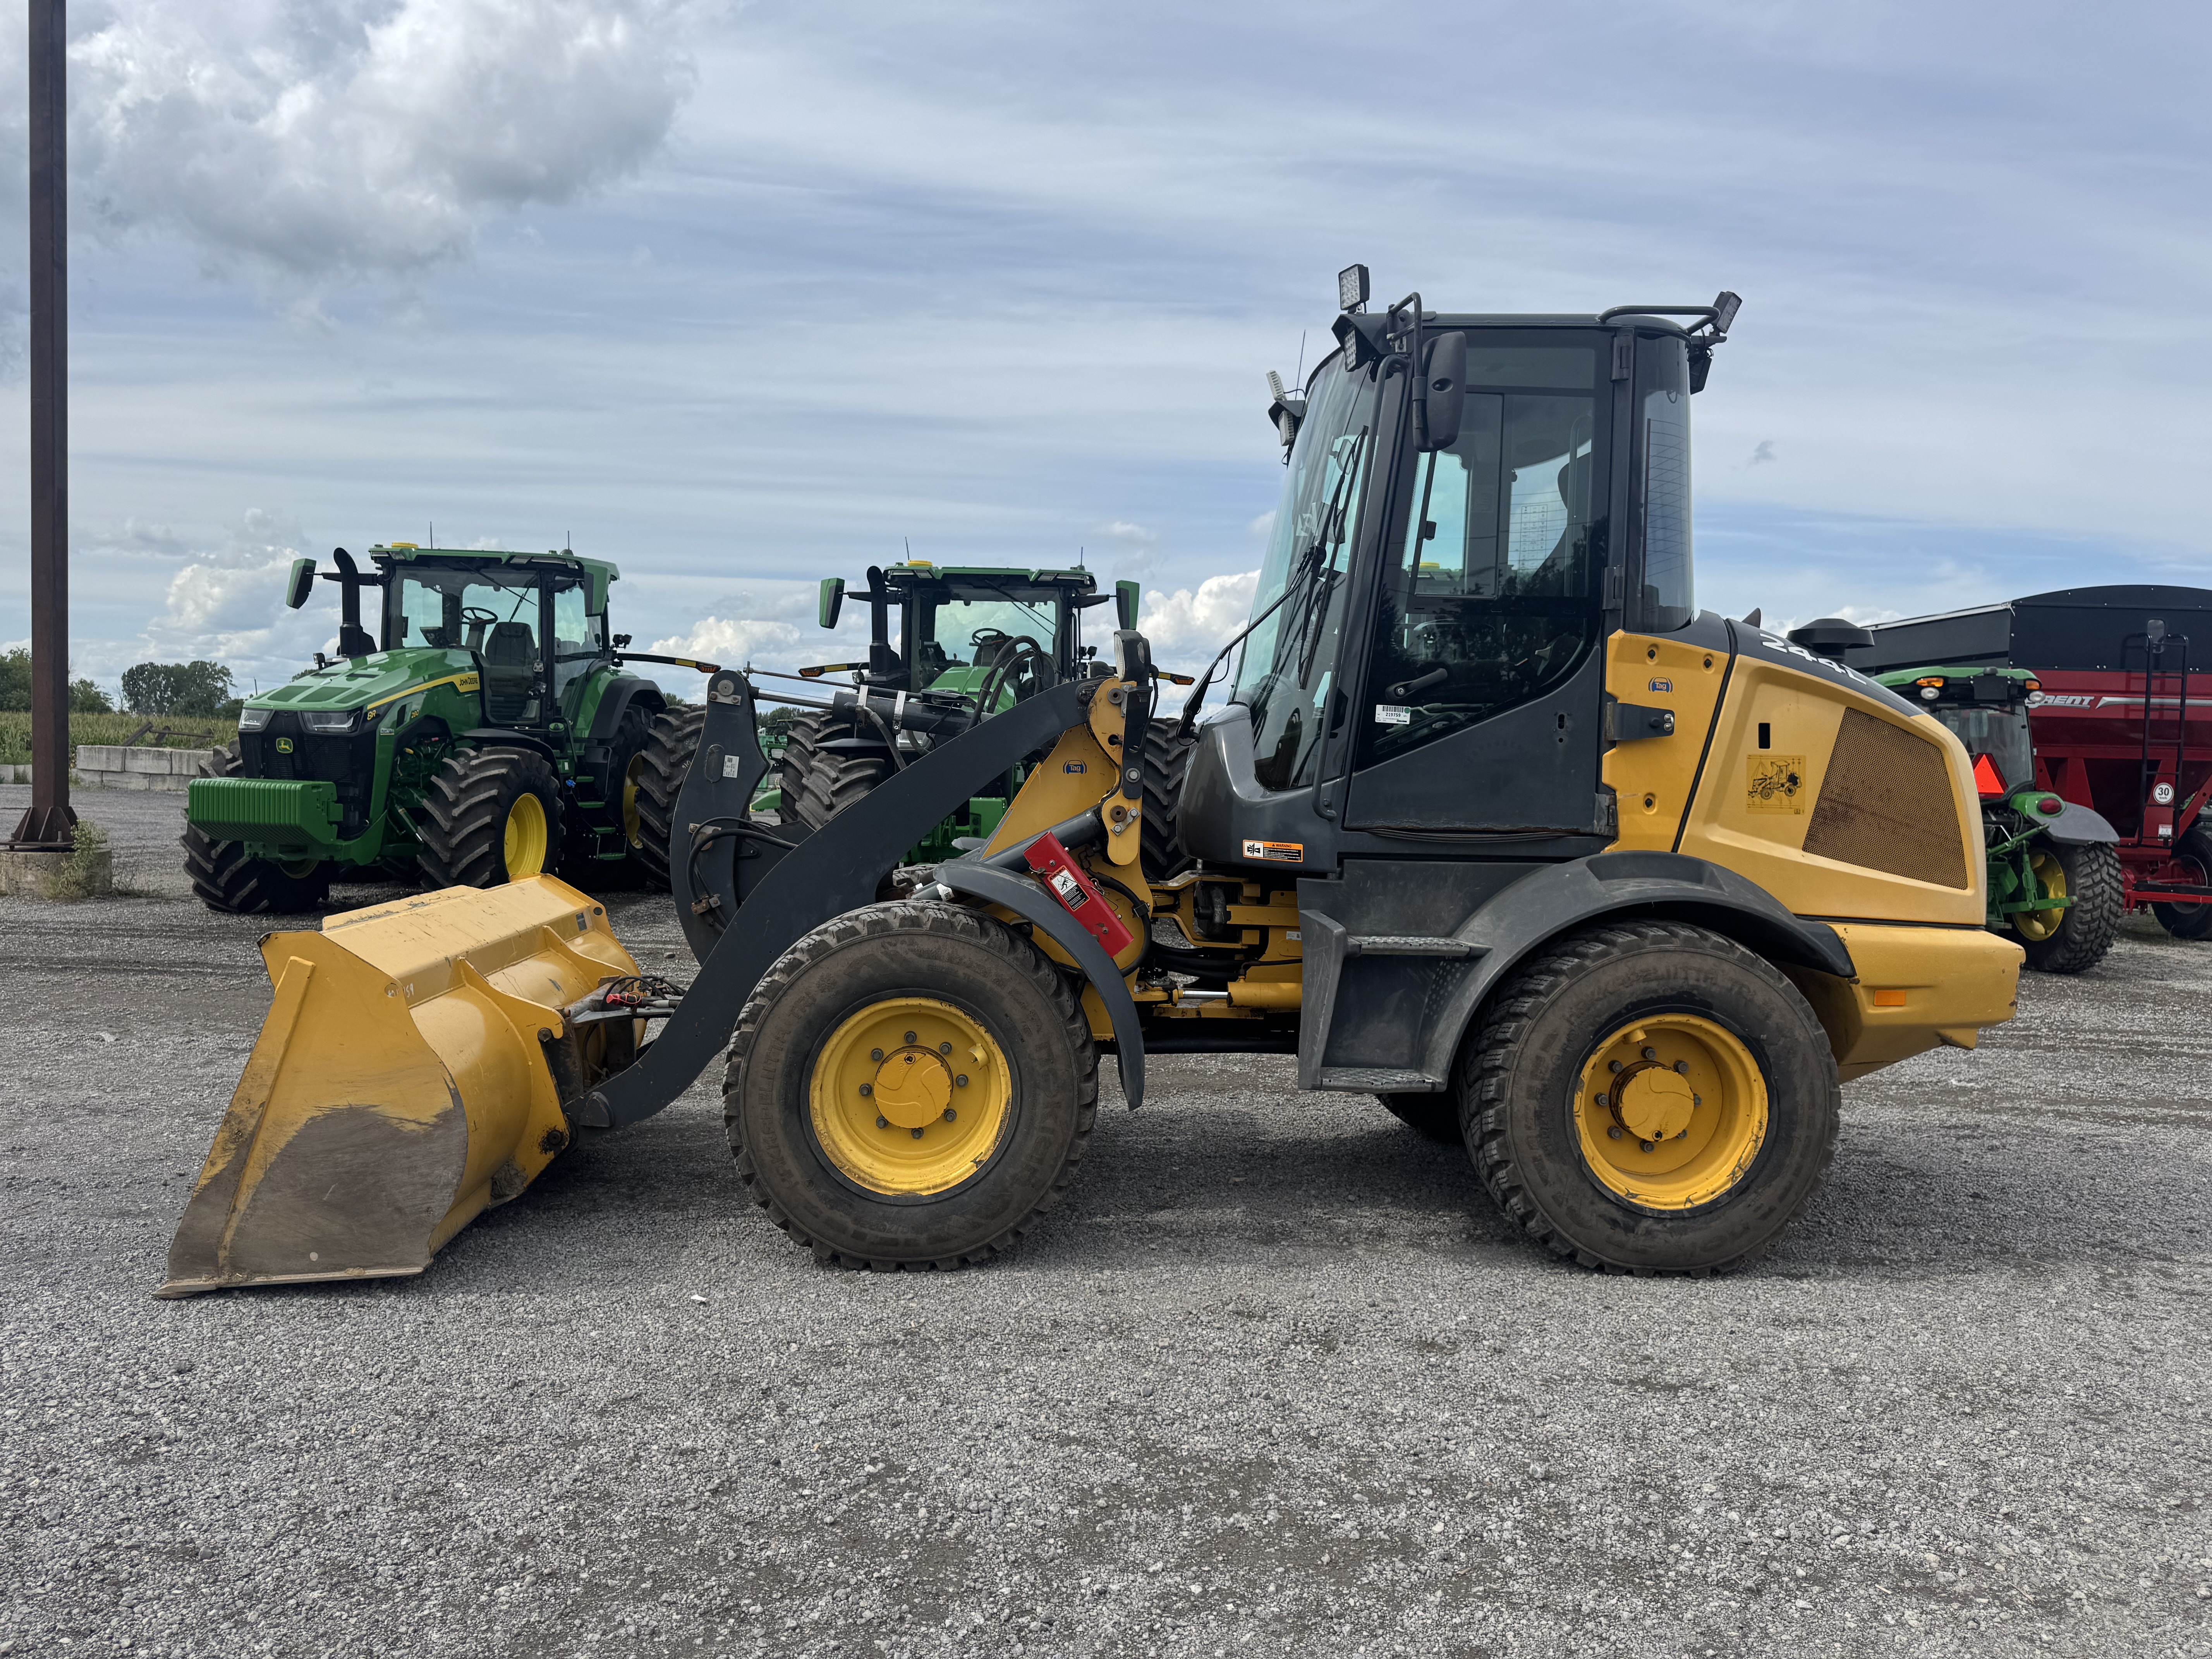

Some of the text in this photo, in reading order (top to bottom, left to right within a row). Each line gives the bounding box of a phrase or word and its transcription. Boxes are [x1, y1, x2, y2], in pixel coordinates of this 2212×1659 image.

[1759, 633, 1867, 685] 244L
[460, 678, 468, 686] JOHN
[2025, 695, 2095, 709] RENT
[367, 709, 376, 721] 8R
[2158, 787, 2169, 796] 30
